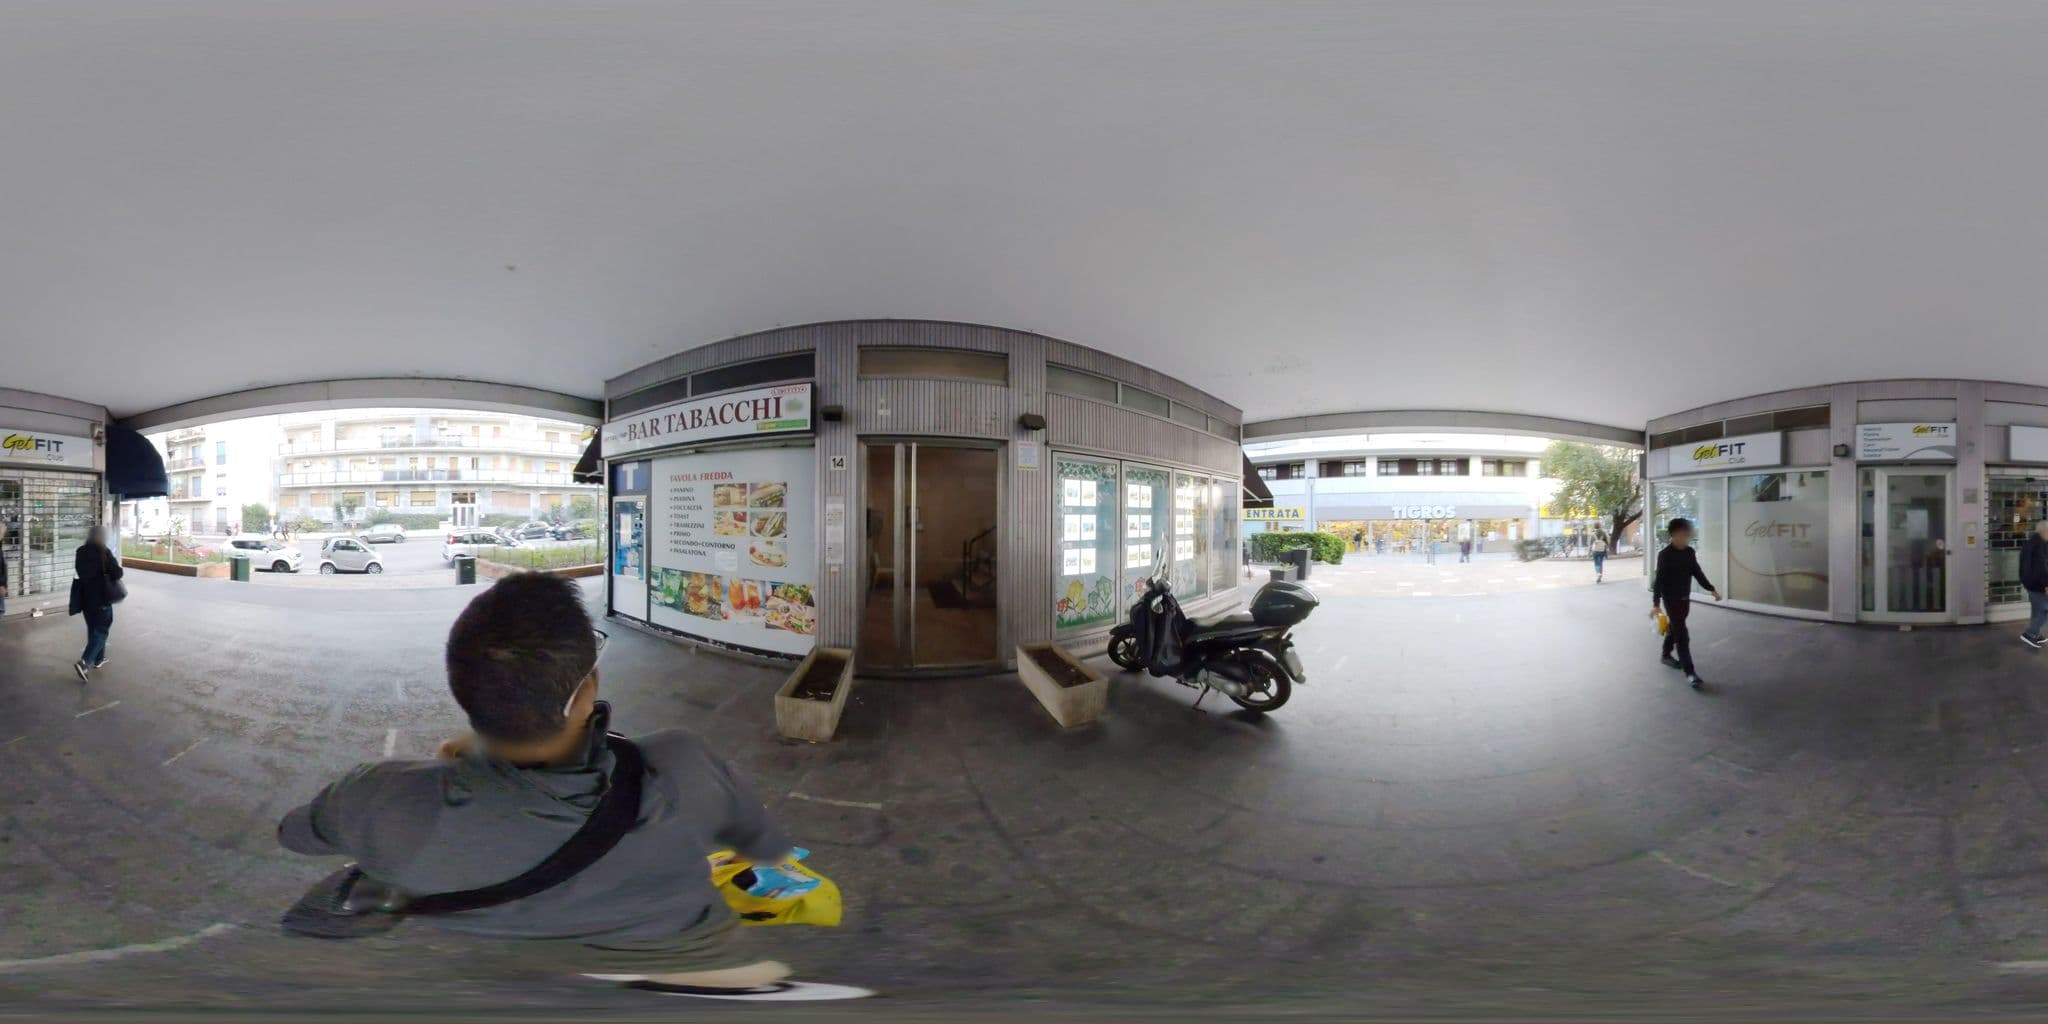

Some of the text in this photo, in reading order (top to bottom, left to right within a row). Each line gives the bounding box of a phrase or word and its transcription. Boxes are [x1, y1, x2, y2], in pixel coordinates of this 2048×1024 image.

[628, 396, 783, 441] BAR TABACCHI
[832, 457, 844, 468] 14
[622, 462, 639, 490] T
[670, 471, 733, 482] TAVOLA FREDDA
[1246, 509, 1299, 518] ENTRATA
[1391, 505, 1457, 519] TIGROS
